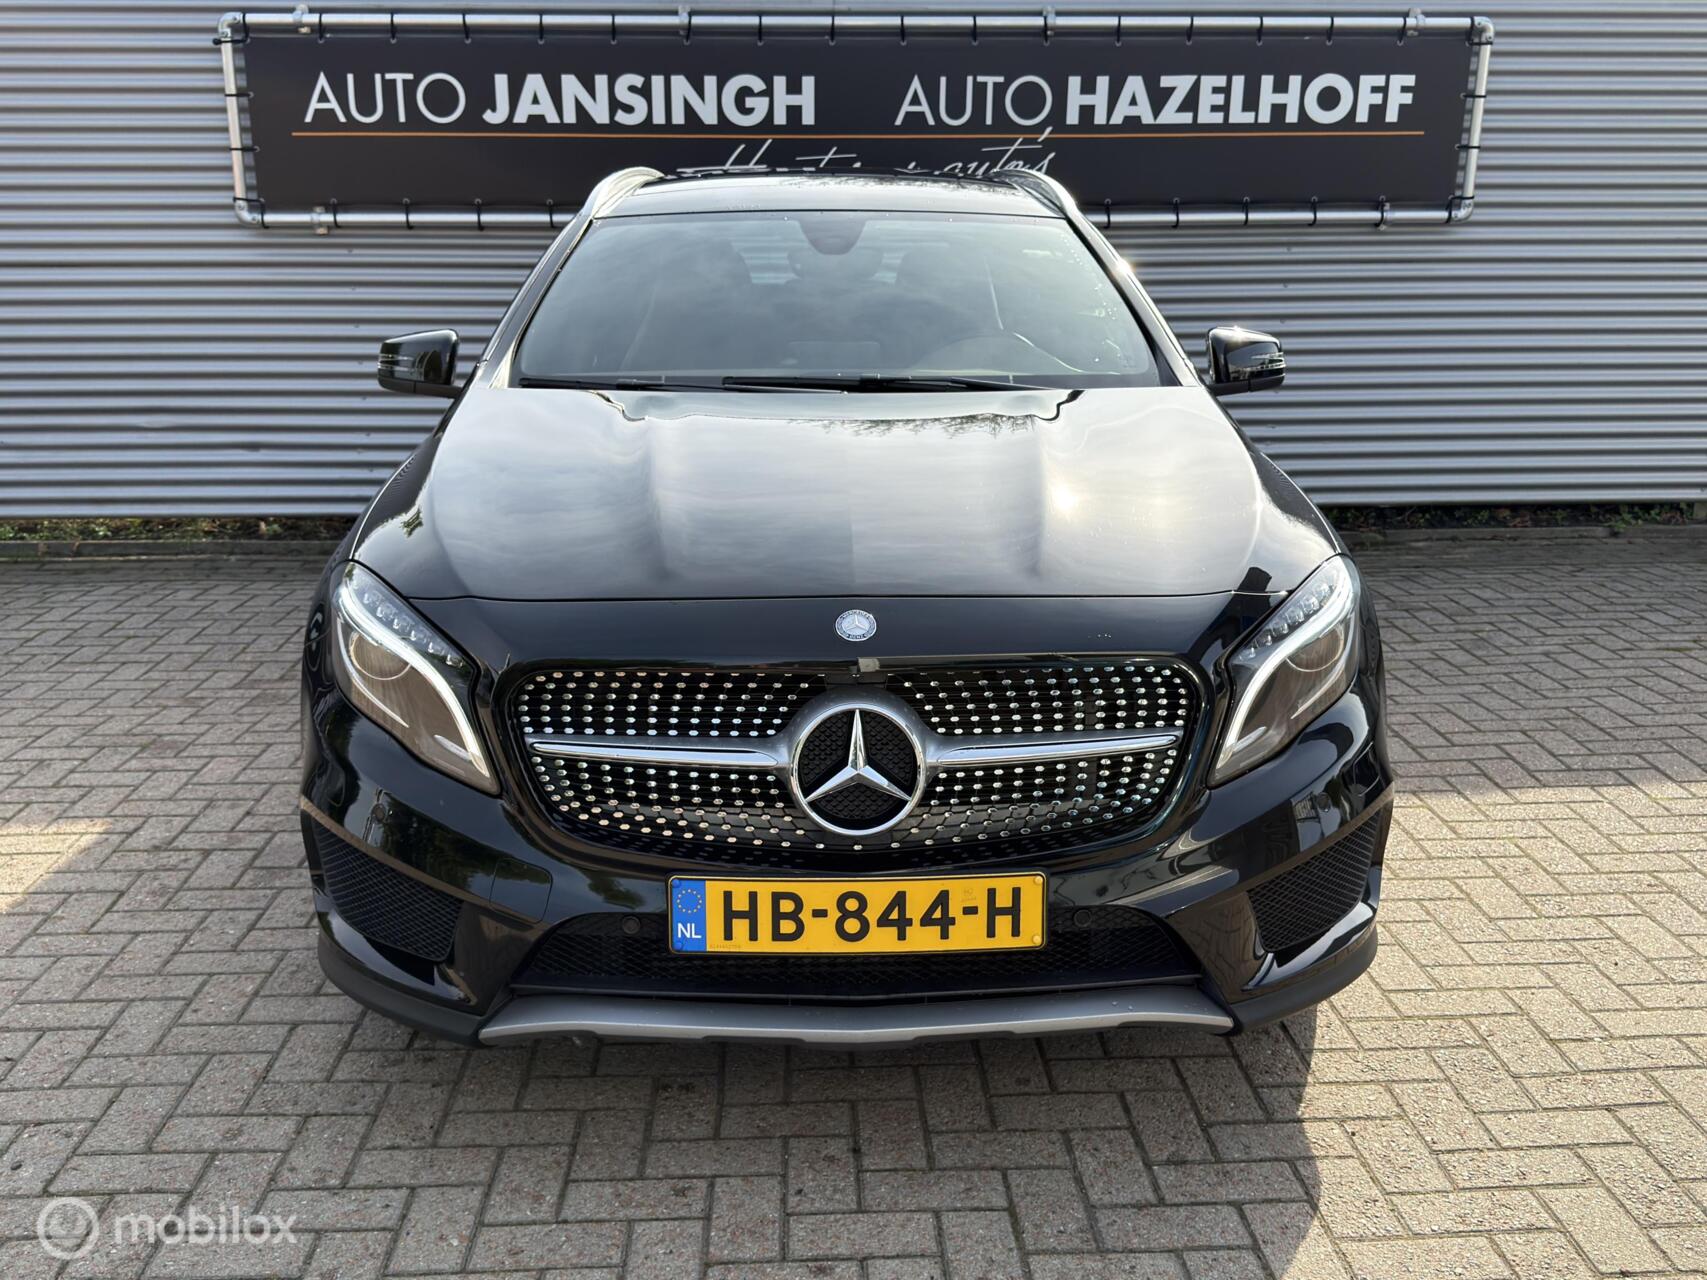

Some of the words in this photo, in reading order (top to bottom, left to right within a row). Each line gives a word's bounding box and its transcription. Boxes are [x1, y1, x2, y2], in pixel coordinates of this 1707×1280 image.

[304, 71, 466, 124] AUTO
[482, 73, 815, 127] JANSINGH
[894, 74, 1053, 126] AUTO
[1065, 72, 1417, 125] HAZELHOFF
[677, 922, 702, 939] NL
[723, 886, 1022, 943] HB-844-H
